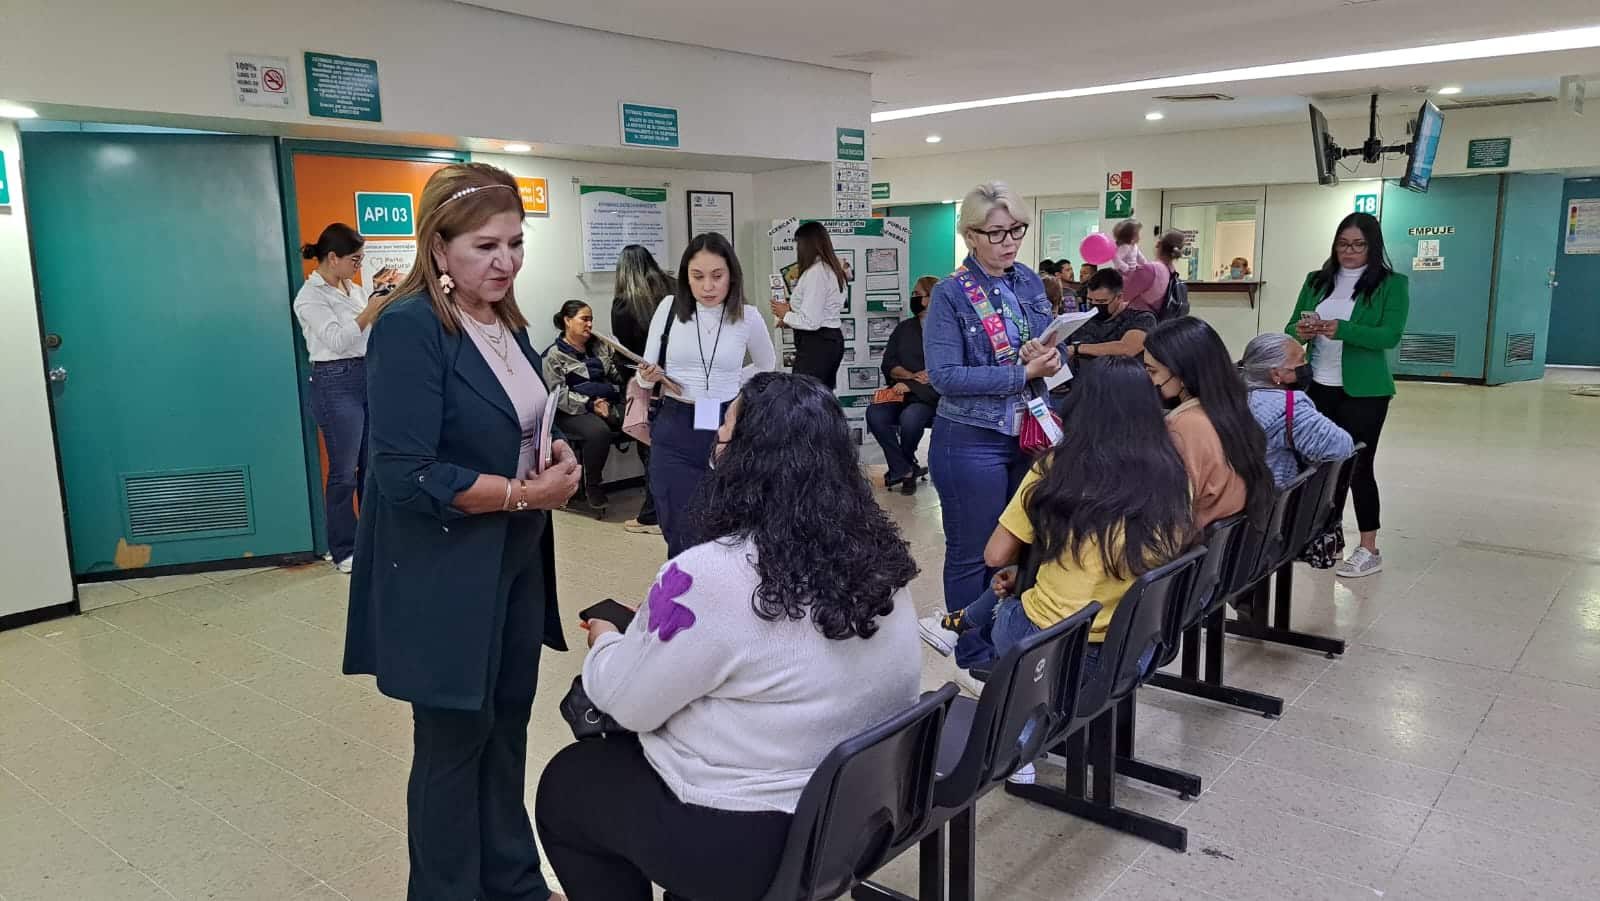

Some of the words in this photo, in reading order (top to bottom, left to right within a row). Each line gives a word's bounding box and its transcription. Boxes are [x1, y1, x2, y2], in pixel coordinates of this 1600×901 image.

[535, 186, 545, 204] 3
[1356, 197, 1376, 213] 18
[364, 206, 389, 222] API
[392, 207, 408, 222] 03
[1408, 226, 1454, 236] EMPUJE
